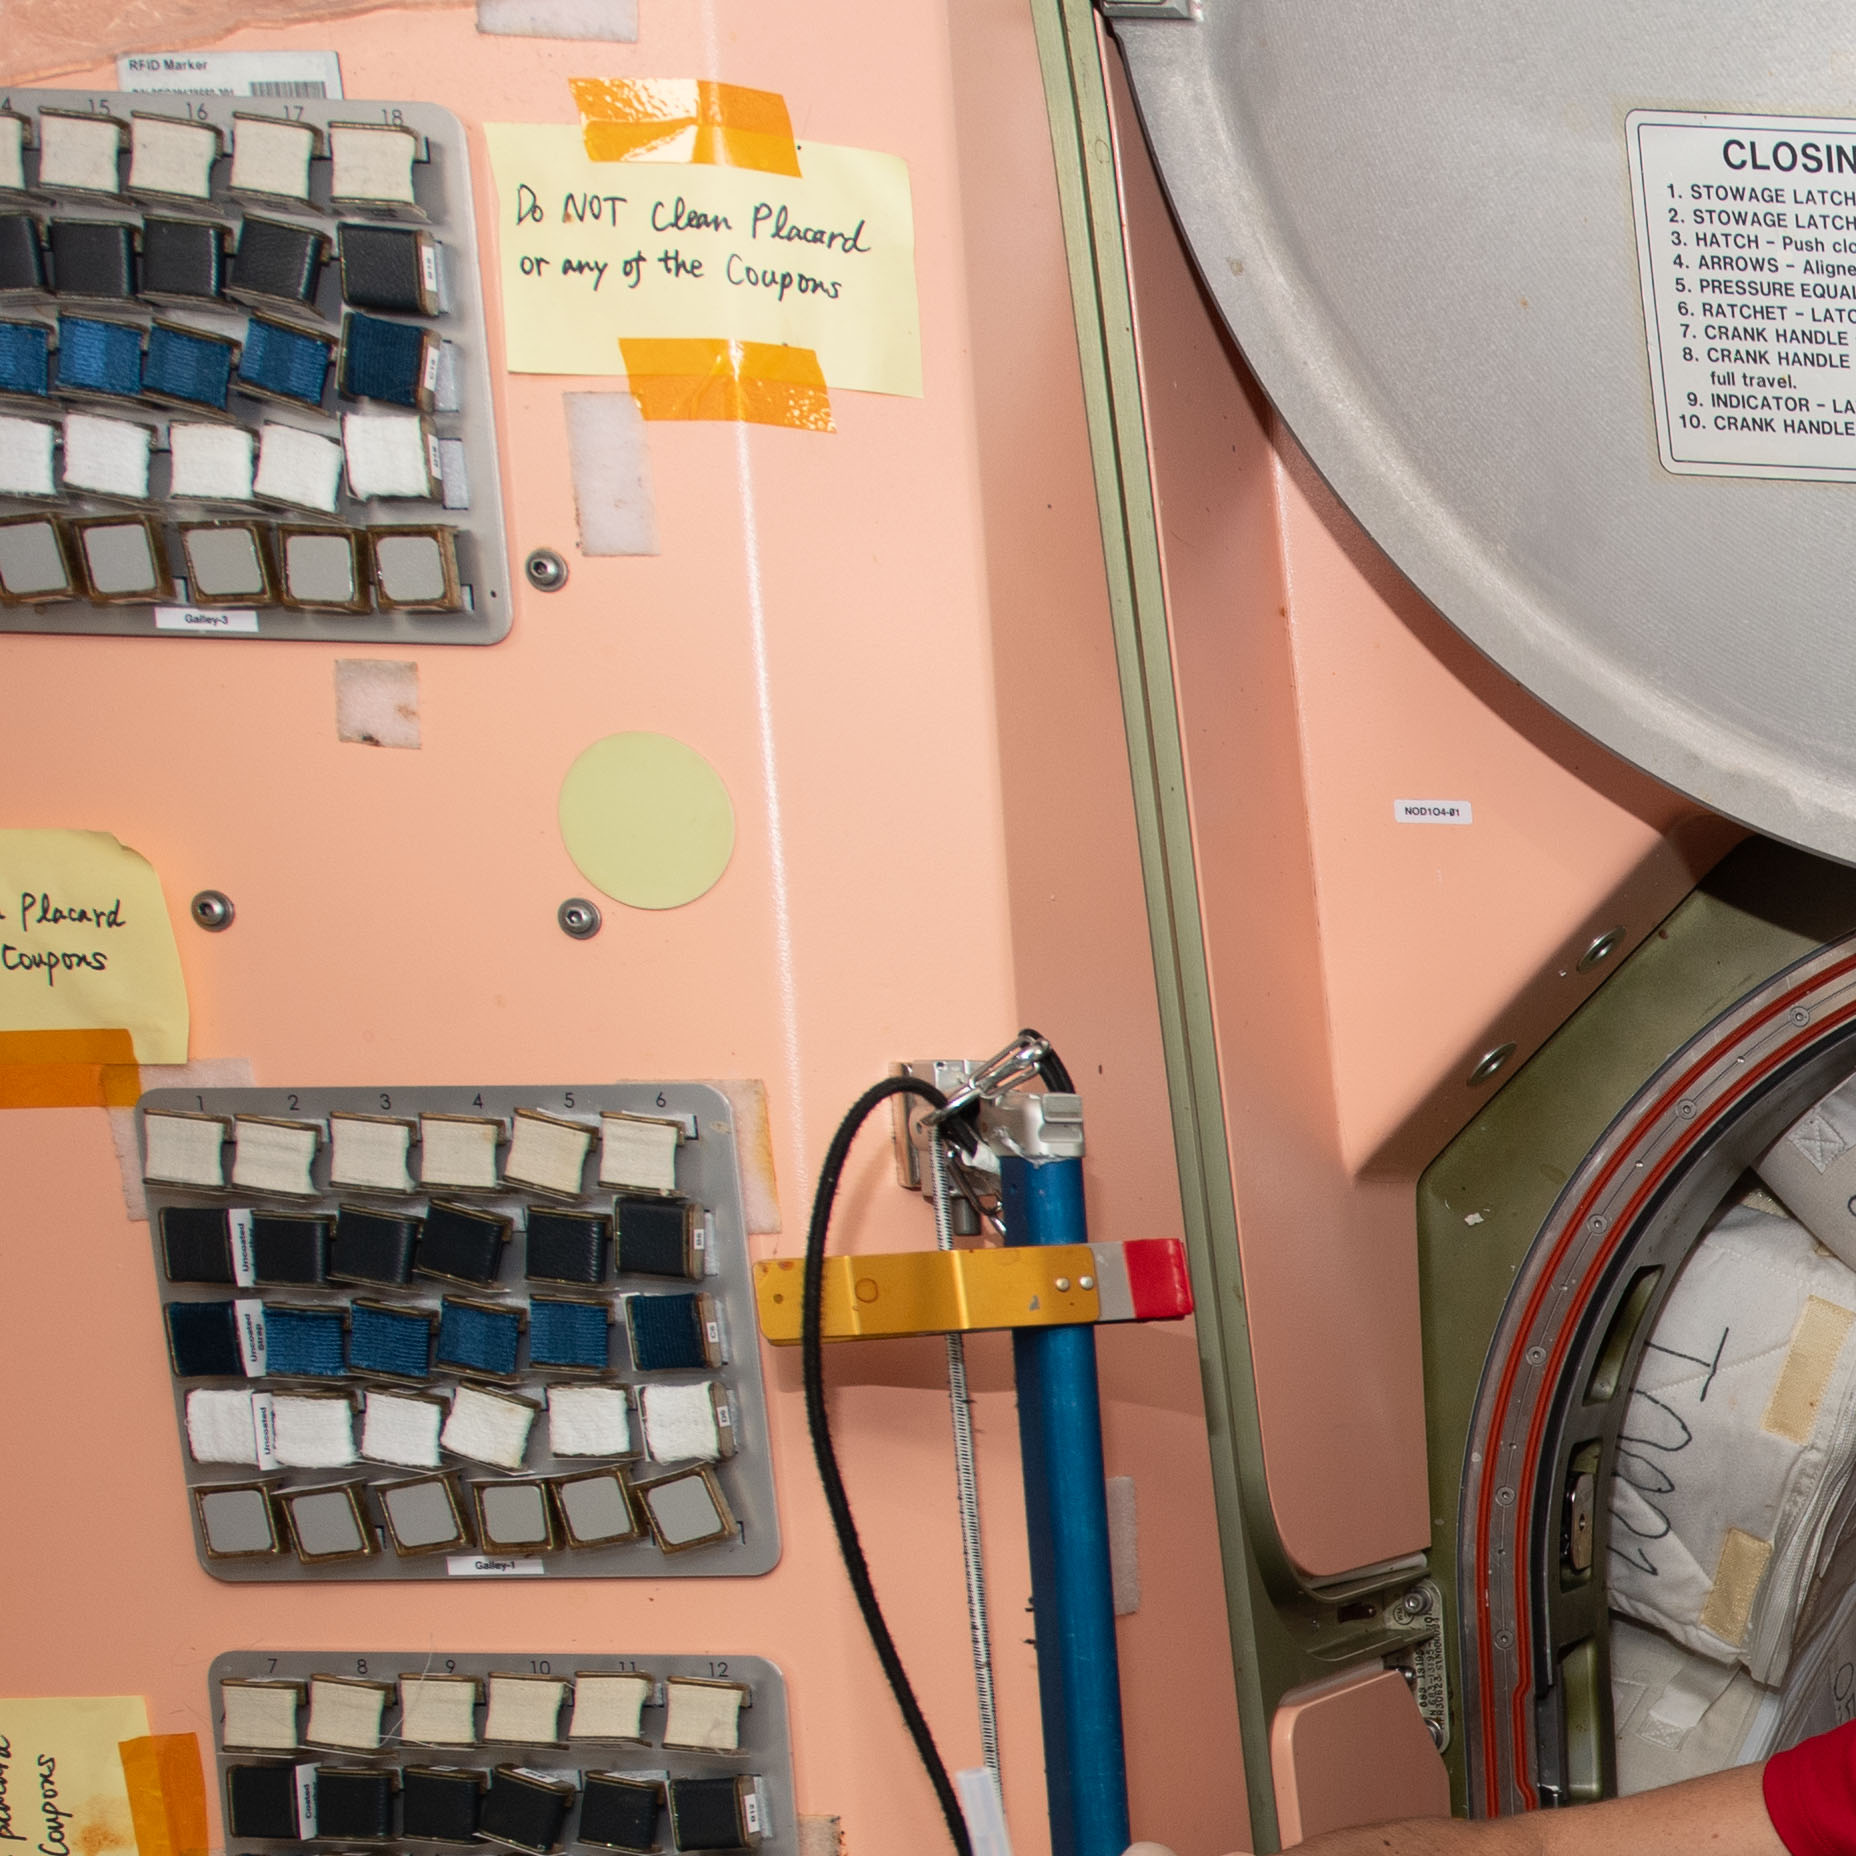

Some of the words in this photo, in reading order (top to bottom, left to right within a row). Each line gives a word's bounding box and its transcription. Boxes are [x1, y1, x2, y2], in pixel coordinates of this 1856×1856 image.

[129, 59, 160, 71] RFID
[165, 59, 207, 71] Marker
[186, 103, 208, 120] 16
[284, 105, 303, 120] 17
[381, 109, 403, 125] 18
[1667, 185, 1683, 200] 1.
[1690, 185, 1786, 203] STOWAGE
[1793, 189, 1856, 207] LATCH
[516, 184, 542, 226] Do
[563, 193, 627, 226] NOT
[652, 196, 732, 232] Clean
[752, 203, 871, 254] Placard
[1669, 209, 1685, 224] 2.
[1693, 210, 1788, 228] STOWAGE
[1672, 231, 1687, 246] 3.
[1696, 233, 1759, 249] HATCH
[1782, 236, 1826, 253] Push
[520, 255, 550, 275] or
[562, 255, 607, 291] any
[623, 251, 646, 288] of
[658, 249, 703, 277] the
[727, 253, 842, 301] Coupons
[1673, 255, 1689, 270] 4.
[1698, 256, 1779, 273] ARROWS
[1676, 278, 1692, 293] 5.
[1700, 279, 1795, 298] PRESSURE
[1678, 301, 1694, 317] 6.
[1702, 302, 1787, 320] RATCHET
[1680, 324, 1697, 339] 7.
[1704, 325, 1767, 343] CRANK
[1775, 328, 1848, 346] HANDLE
[1683, 347, 1699, 362] 8.
[1707, 348, 1770, 365] CRANK
[1778, 351, 1850, 369] HANDLE
[1711, 370, 1736, 387] full
[1742, 372, 1796, 389] travel.
[1687, 393, 1704, 408] 9.
[1712, 394, 1810, 412] INDICATOR
[1679, 415, 1706, 430] 10.
[1714, 416, 1776, 434] CRANK
[1783, 419, 1855, 437] HANDLE
[185, 613, 229, 628] Galley-3
[21, 892, 126, 932] Placard
[2, 944, 108, 987] Coupons
[198, 1095, 204, 1110] 1
[289, 1095, 299, 1110] 2
[381, 1095, 391, 1110] 3
[473, 1093, 483, 1109] 4
[565, 1093, 575, 1109] 5
[656, 1092, 666, 1108] 6
[238, 1223, 250, 1272] Uncoated
[244, 1313, 258, 1363] Uncoated
[254, 1323, 265, 1351] Strap
[475, 1559, 517, 1574] Galley-1
[268, 1659, 277, 1673] 7
[357, 1659, 367, 1675] 8
[445, 1660, 454, 1674] 9
[530, 1661, 550, 1675] 10
[709, 1662, 728, 1678] 12
[38, 1753, 73, 1856] Coupons
